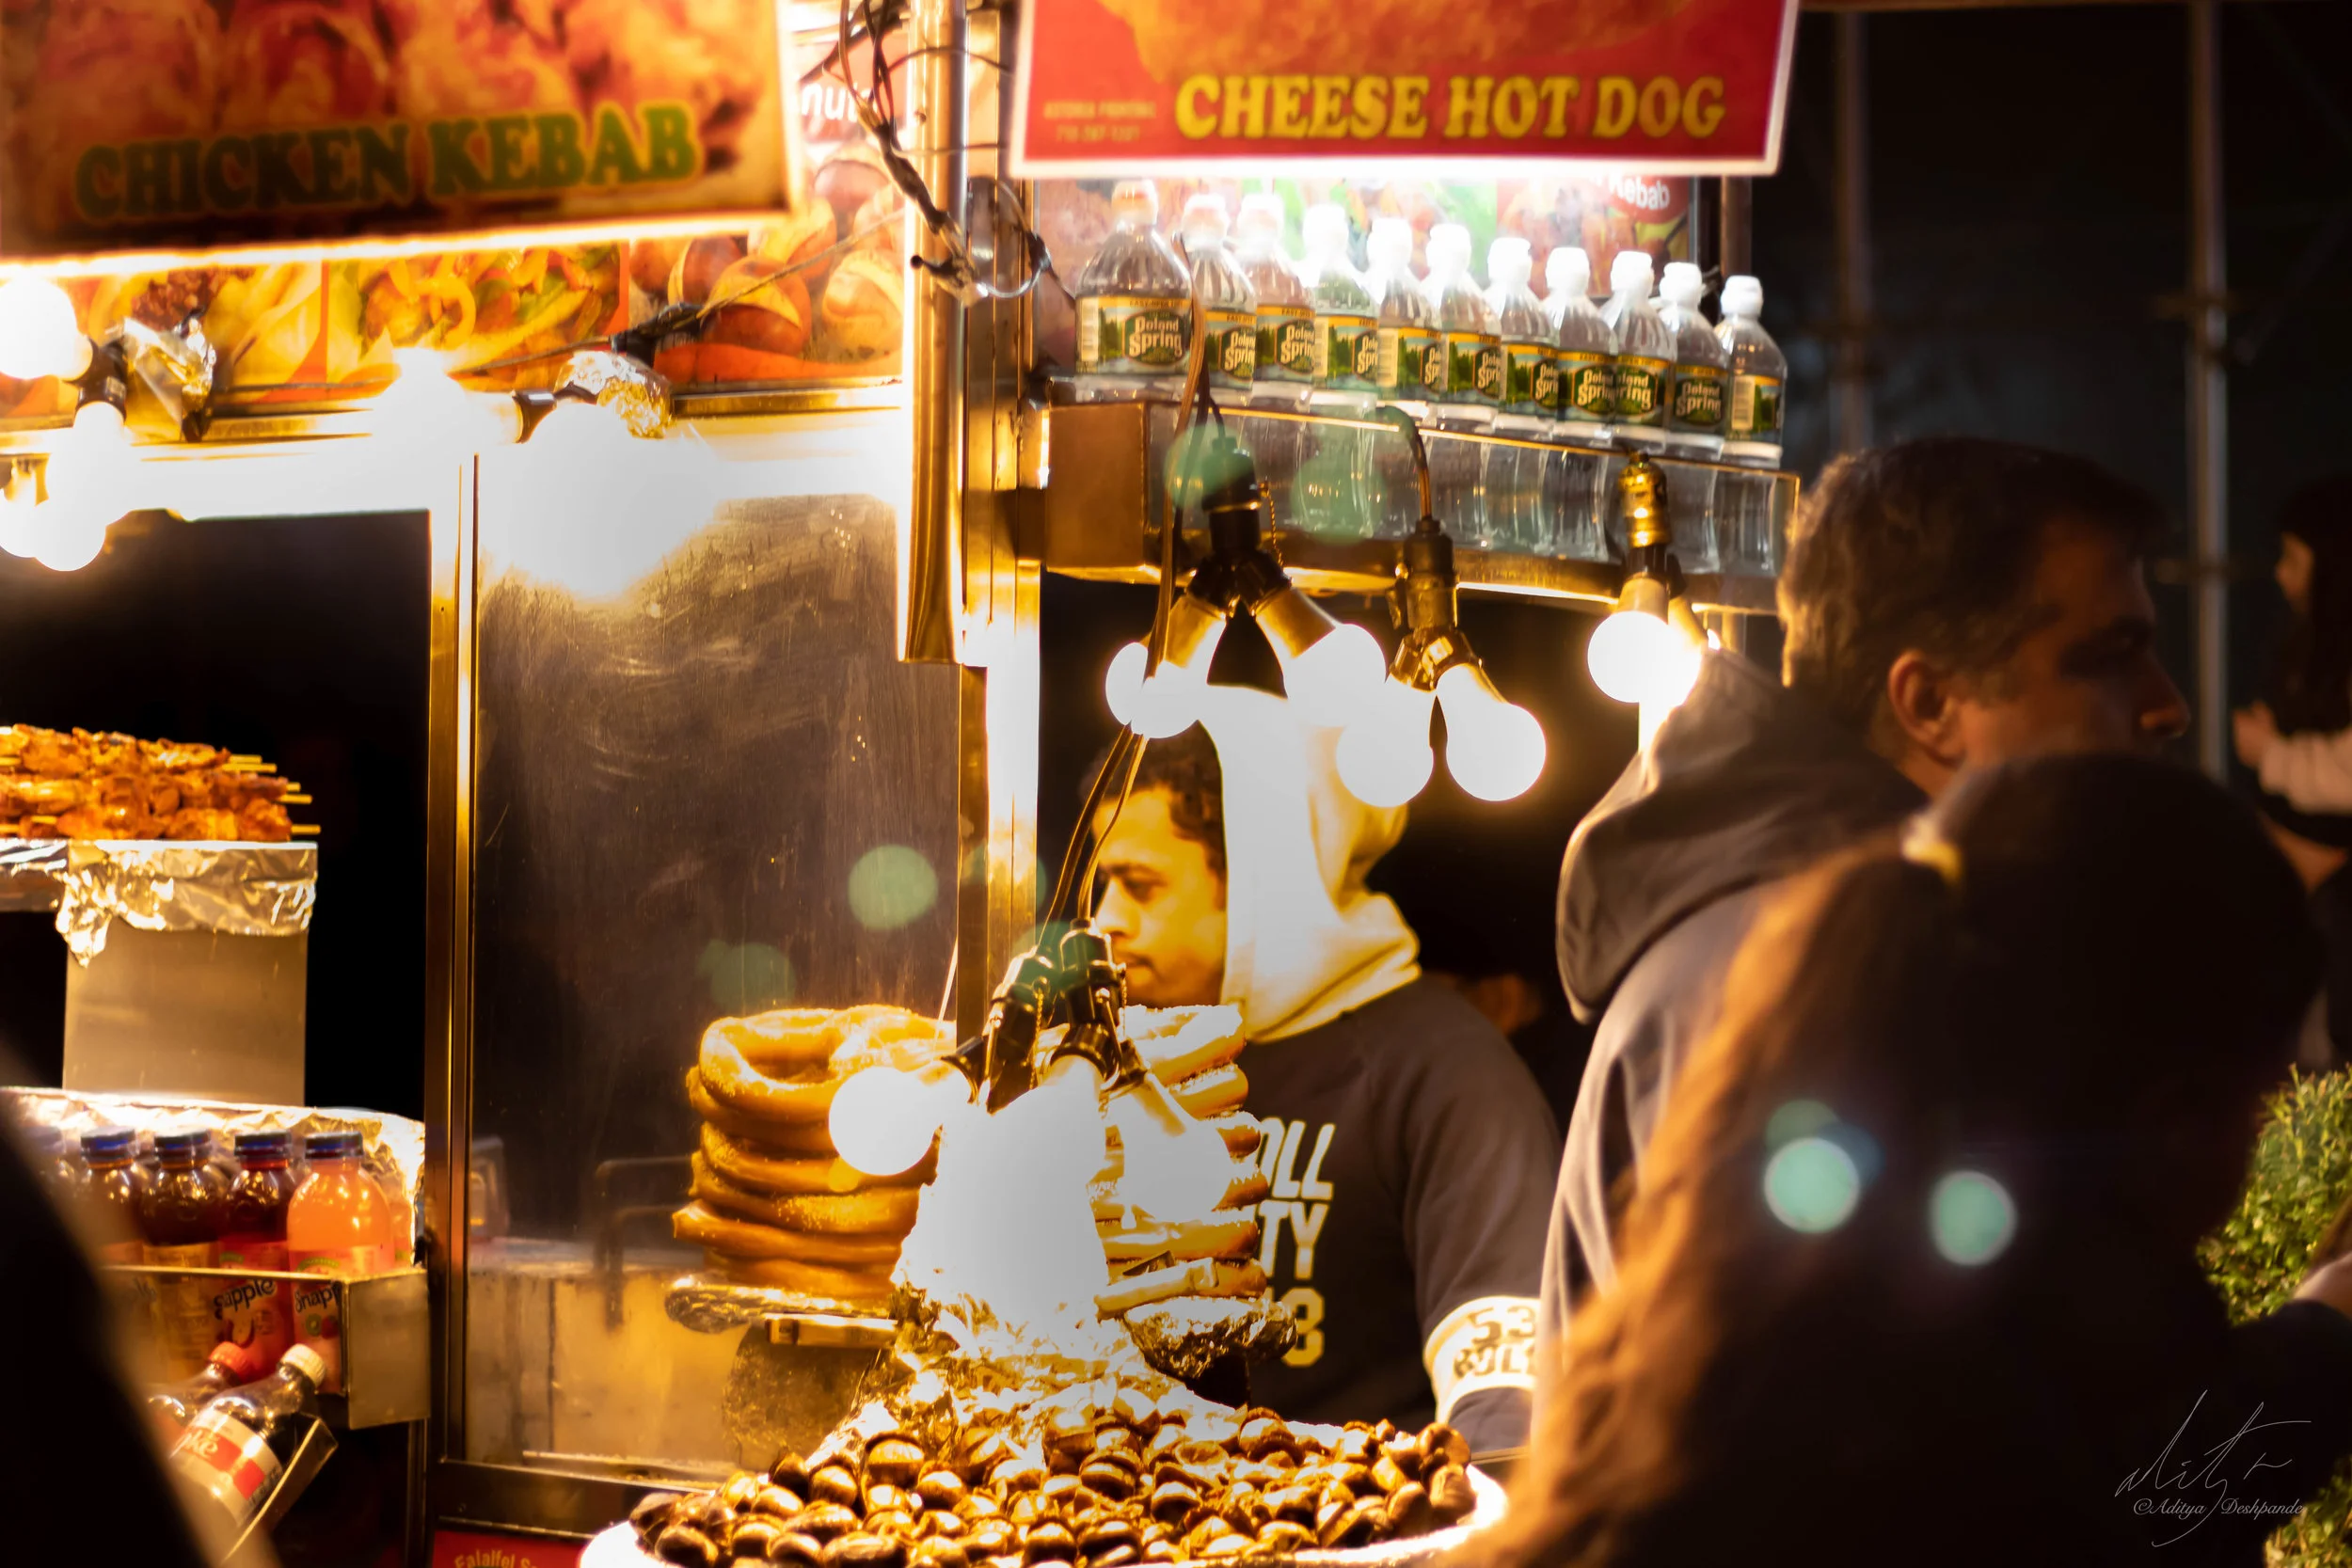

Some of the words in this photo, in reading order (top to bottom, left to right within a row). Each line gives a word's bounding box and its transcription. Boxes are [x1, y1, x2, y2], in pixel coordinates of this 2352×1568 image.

[1175, 74, 1429, 139] CHEESE
[1443, 74, 1581, 138] HOT
[1592, 74, 1726, 138] DOG
[74, 124, 412, 220] CHICKEN
[426, 102, 703, 197] KEBAB
[1135, 315, 1180, 334] Poland
[1129, 330, 1183, 357] Spring
[1231, 330, 1256, 348] Polan
[1224, 346, 1256, 371] Sprin
[1619, 383, 1651, 411] ring
[1681, 381, 1720, 397] Poland
[1676, 393, 1722, 420] Spring
[1257, 1117, 1336, 1201] OLL
[1257, 1200, 1329, 1280] TY
